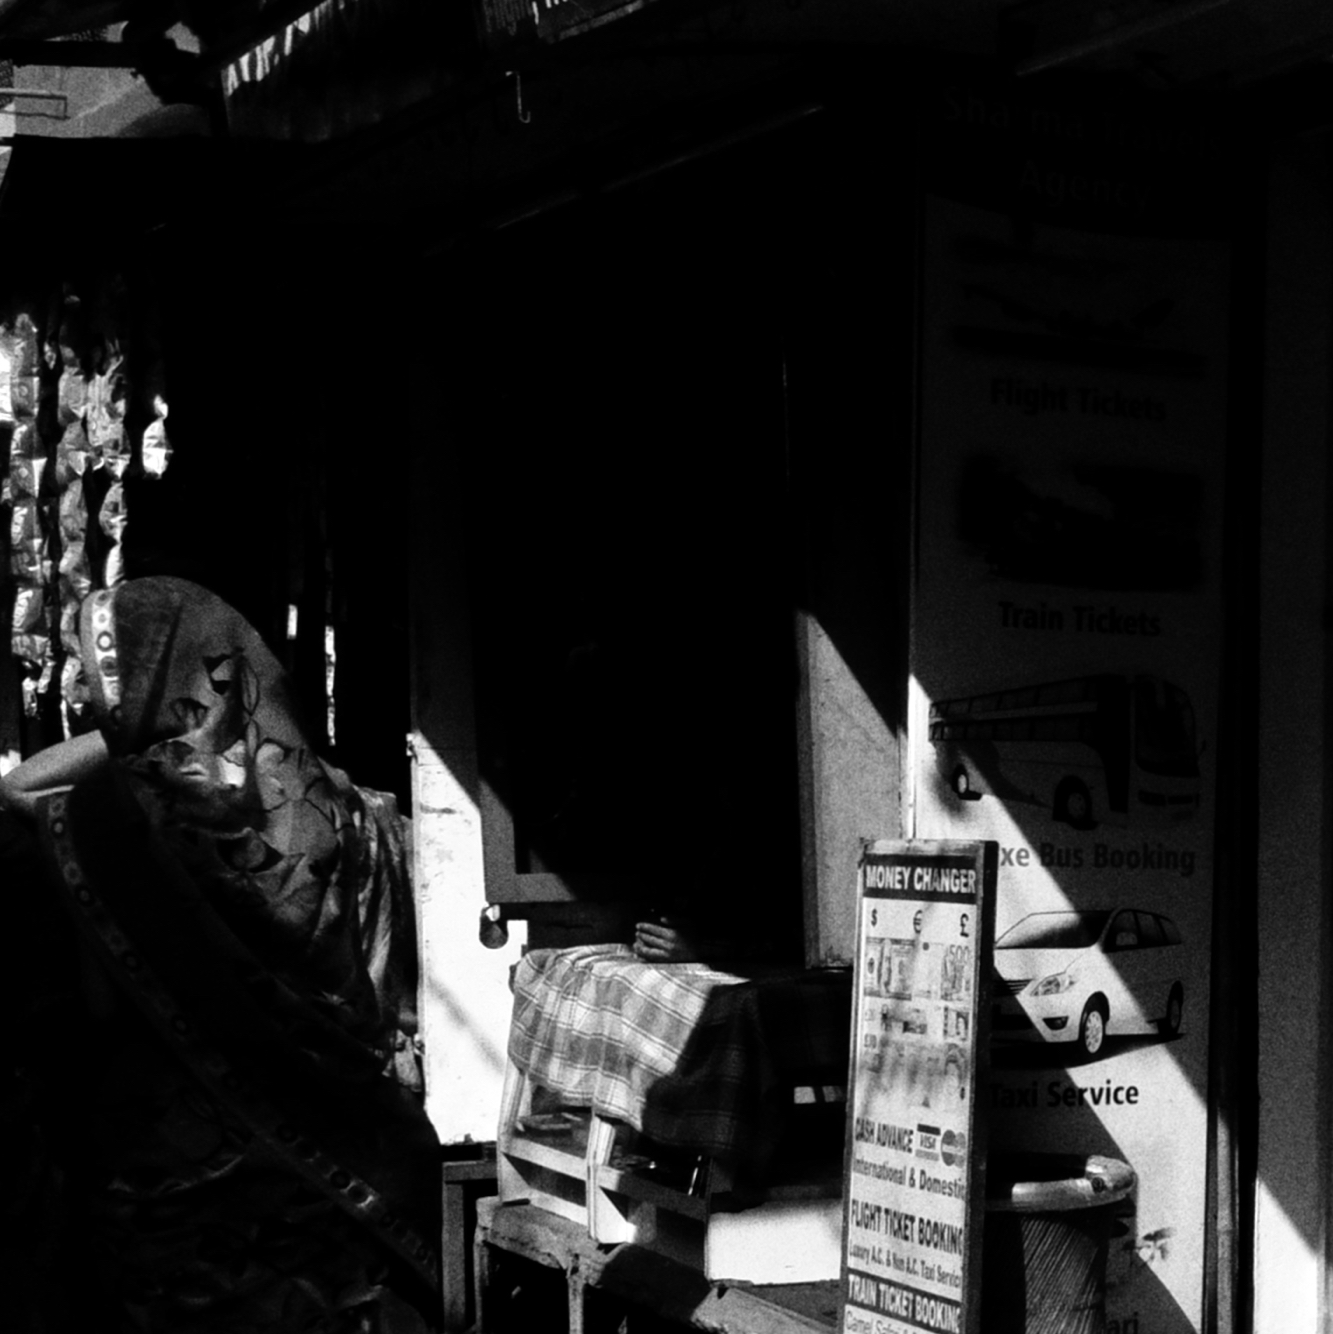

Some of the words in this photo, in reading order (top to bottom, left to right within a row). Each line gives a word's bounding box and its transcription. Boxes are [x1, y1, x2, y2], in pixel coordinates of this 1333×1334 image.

[1018, 159, 1151, 218] Agency
[990, 377, 1069, 416] Flight
[1076, 386, 1167, 423] Tickets
[998, 601, 1064, 634] Train
[1073, 605, 1161, 638] Tickets
[1040, 842, 1083, 869] Bus
[1092, 845, 1197, 877] Booking
[866, 865, 911, 890] MONEY
[913, 866, 977, 894] CHANGER
[871, 907, 879, 928] $
[959, 912, 970, 939] £
[989, 1080, 1040, 1108] Taxi
[1047, 1077, 1140, 1108] Service
[855, 1116, 875, 1144] CASH
[876, 1122, 915, 1154] ADVANCE
[853, 1156, 907, 1187] International
[908, 1166, 917, 1188] &
[851, 1198, 882, 1233] FLIGHT
[884, 1207, 917, 1244] TICKET
[849, 1273, 877, 1307] TRAIN
[879, 1282, 914, 1319] TICKET
